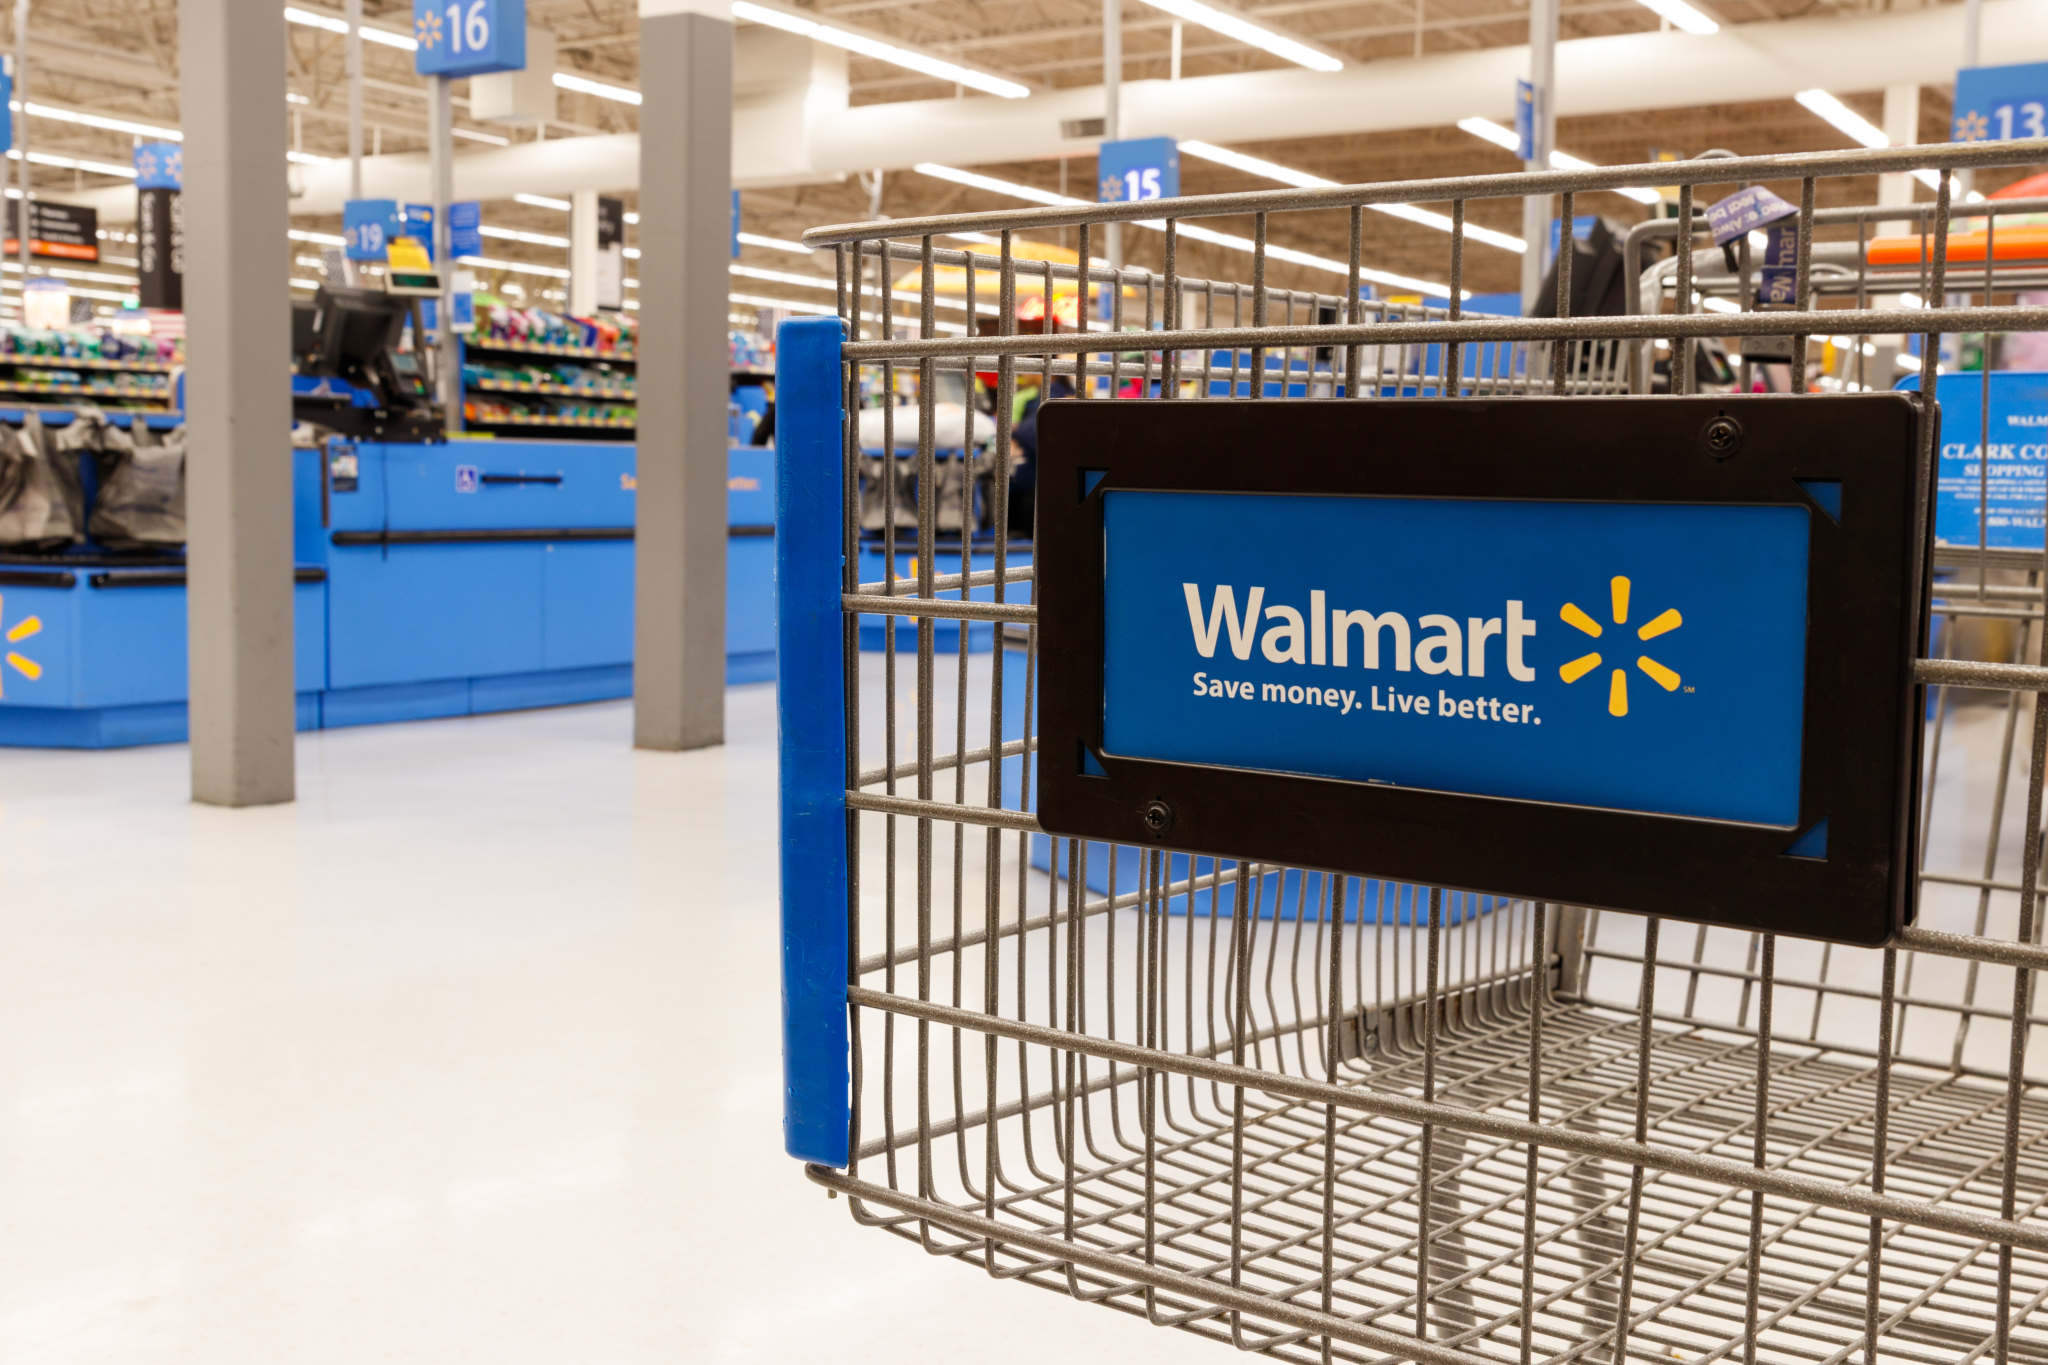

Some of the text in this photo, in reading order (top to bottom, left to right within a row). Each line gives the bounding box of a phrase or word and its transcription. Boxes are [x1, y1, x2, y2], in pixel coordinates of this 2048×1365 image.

[446, 0, 489, 53] 16
[1994, 102, 2045, 140] 13
[1125, 168, 1161, 201] 15
[359, 223, 383, 252] 19
[2007, 415, 2048, 427] WALM
[1942, 443, 2048, 460] CLARK CO
[1183, 583, 1536, 682] Walmart
[1193, 672, 1541, 725] Save money. Live better.
